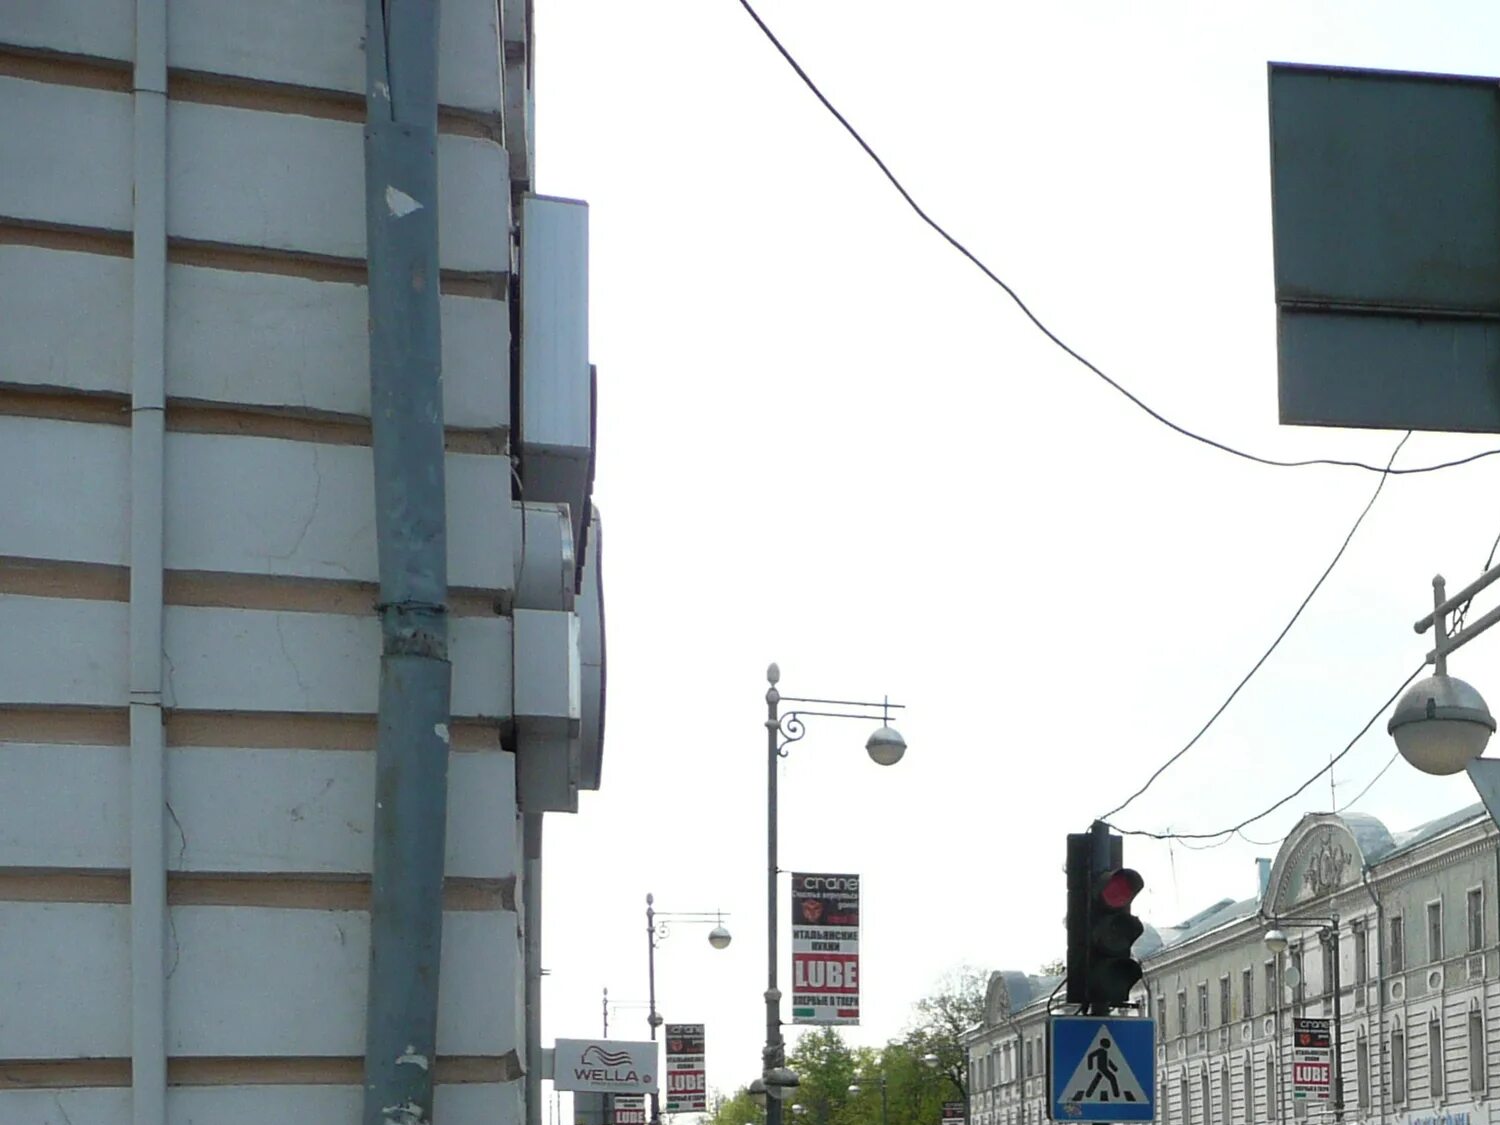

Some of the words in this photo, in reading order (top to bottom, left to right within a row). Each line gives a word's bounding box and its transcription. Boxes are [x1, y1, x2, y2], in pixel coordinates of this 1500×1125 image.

[793, 930, 858, 941] ИТАЛЬЯНСКИЕ
[795, 960, 858, 988] LUBE
[574, 1068, 639, 1082] WELLA
[1296, 1066, 1329, 1082] LUBE
[668, 1074, 705, 1091] LUBE
[616, 1111, 644, 1124] LUBE
